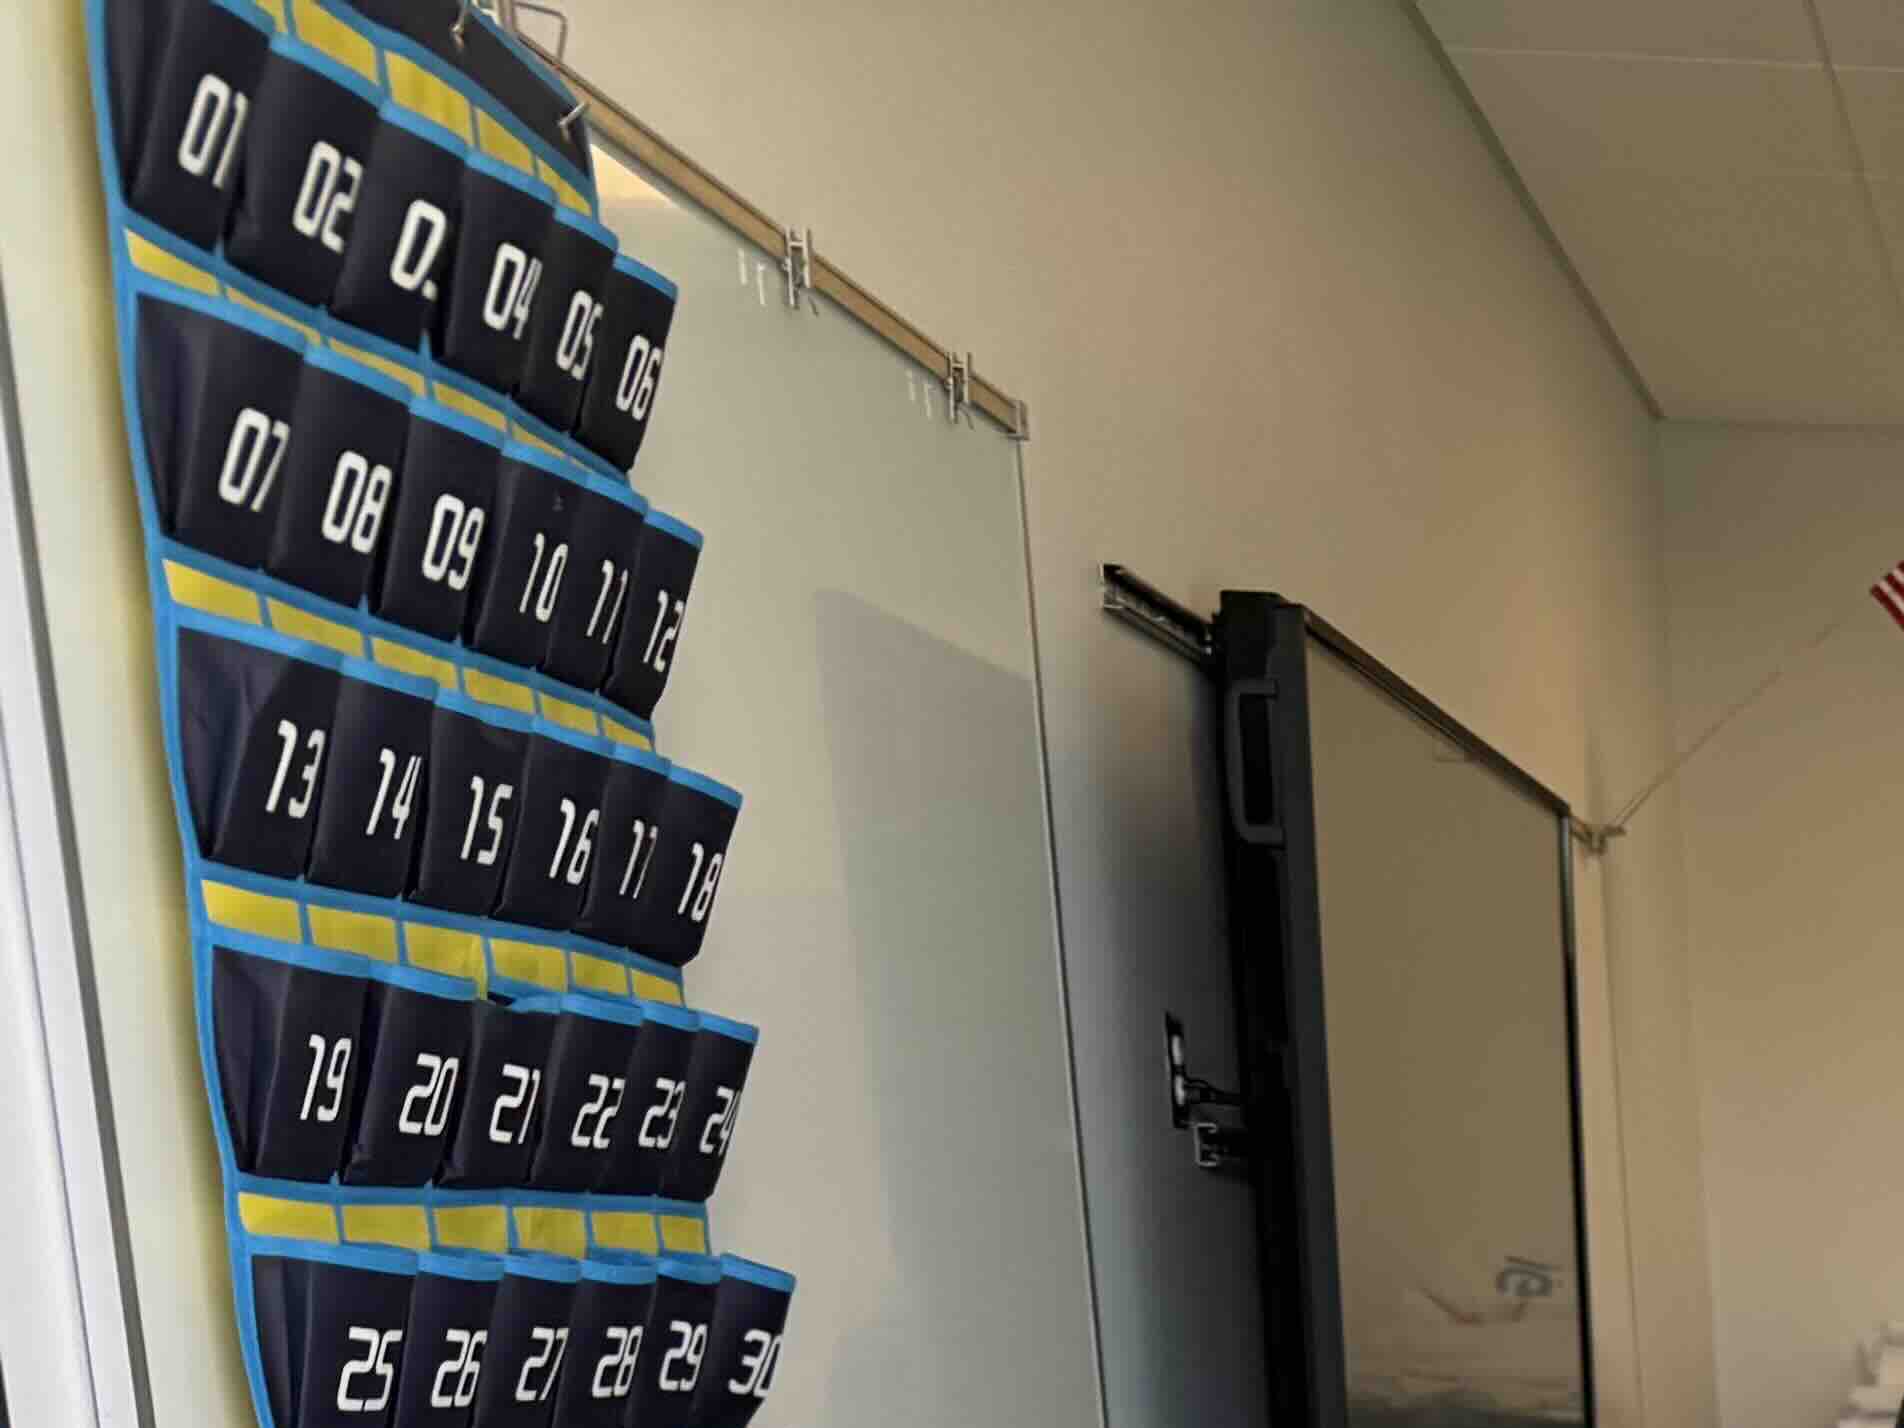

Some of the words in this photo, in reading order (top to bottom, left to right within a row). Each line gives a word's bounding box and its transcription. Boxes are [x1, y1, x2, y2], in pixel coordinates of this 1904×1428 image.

[178, 75, 249, 188] 01
[293, 142, 363, 253] 02
[391, 200, 446, 298] 0
[484, 243, 541, 338] 04
[557, 291, 601, 379] 05
[615, 335, 663, 422] 06
[219, 408, 289, 512] 07
[322, 451, 391, 553] 08
[422, 494, 484, 590] 09
[520, 533, 568, 621] 10
[585, 560, 628, 644] 11
[643, 590, 685, 673] 12
[266, 720, 324, 818] 13
[366, 749, 421, 839] 14
[461, 776, 512, 864] 15
[550, 799, 599, 884] 16
[677, 842, 722, 922] 18
[300, 1035, 351, 1121] 19
[399, 1053, 458, 1135] 20
[490, 1064, 540, 1144] 21
[572, 1074, 625, 1148] 22
[638, 1077, 685, 1149] 23
[337, 1327, 402, 1411] 25
[431, 1329, 487, 1407] 26
[516, 1327, 568, 1400] 27
[592, 1326, 643, 1397] 28
[660, 1321, 707, 1390] 29
[728, 1329, 784, 1400] 30
